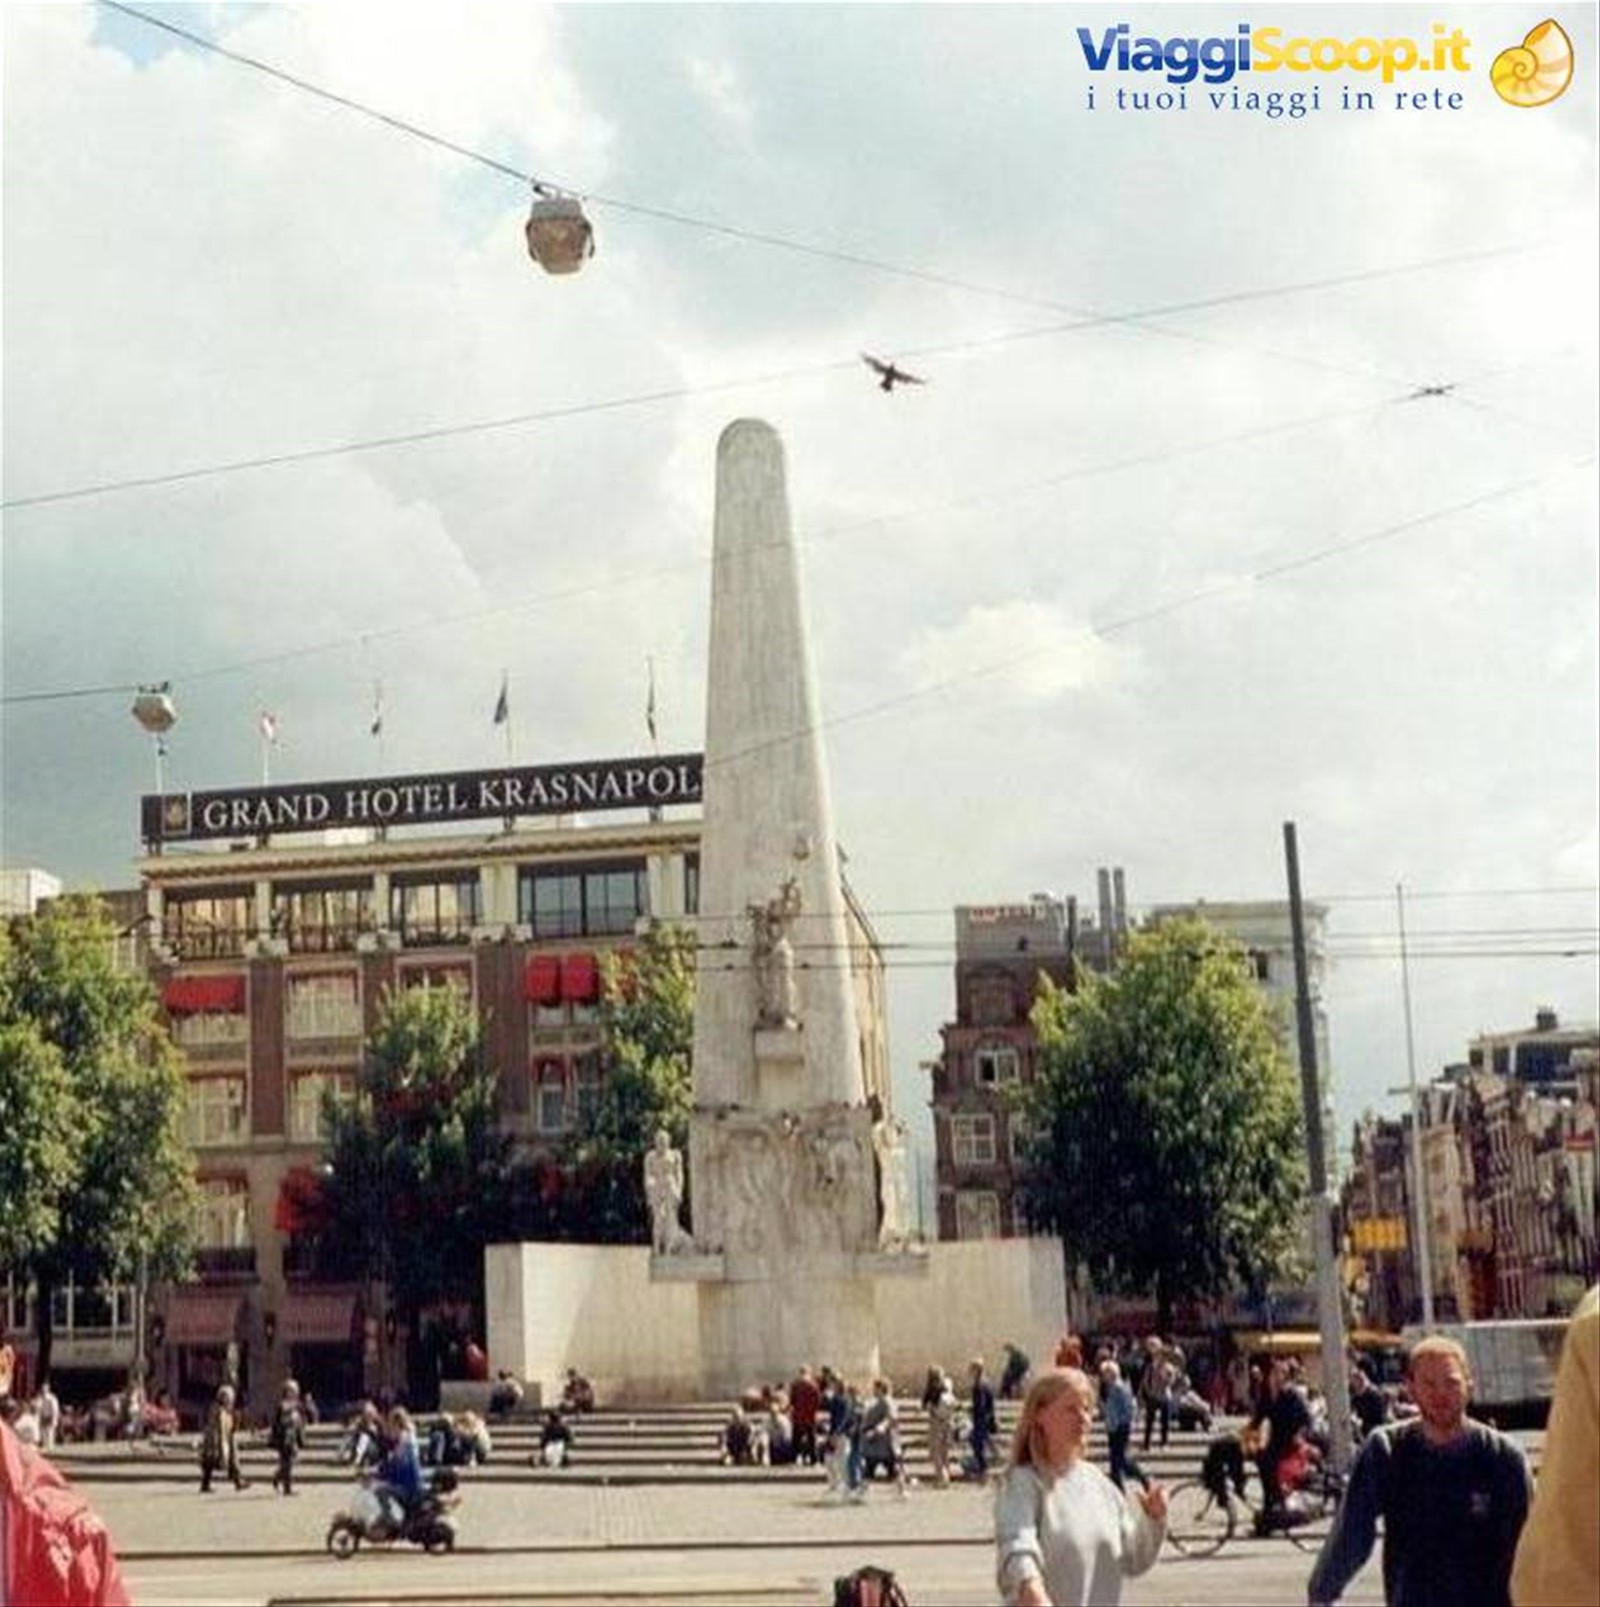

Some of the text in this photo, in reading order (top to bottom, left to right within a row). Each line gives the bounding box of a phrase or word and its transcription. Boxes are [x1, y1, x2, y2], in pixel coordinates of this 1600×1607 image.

[203, 764, 699, 830] GRAND HOTEL KRASNAPOL
